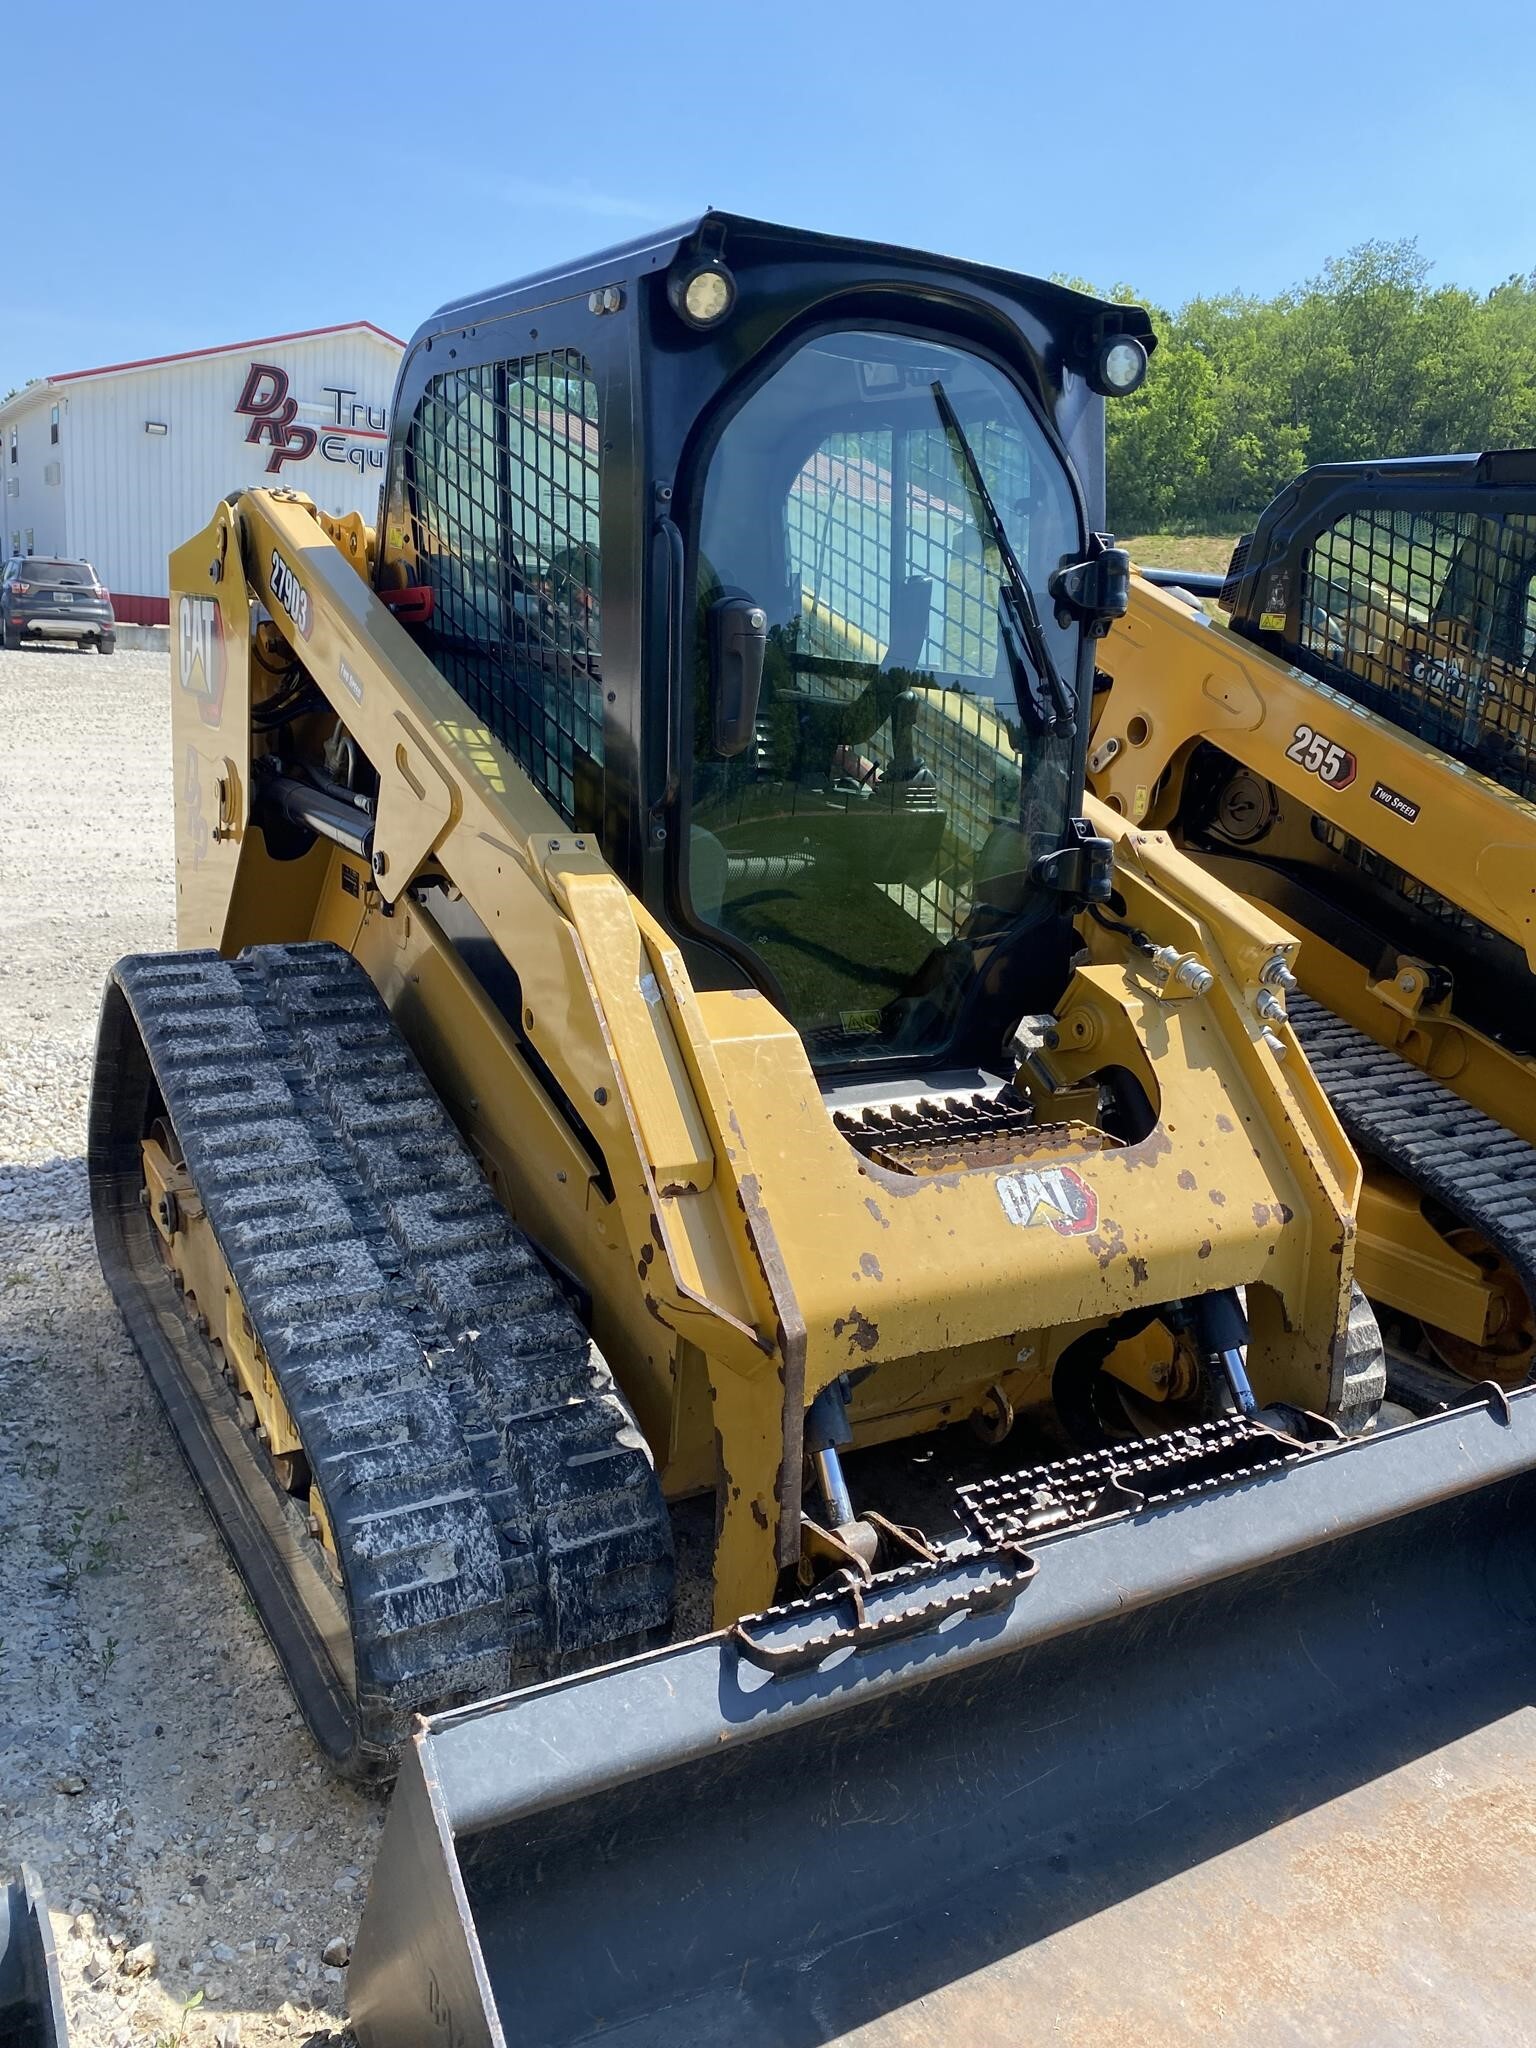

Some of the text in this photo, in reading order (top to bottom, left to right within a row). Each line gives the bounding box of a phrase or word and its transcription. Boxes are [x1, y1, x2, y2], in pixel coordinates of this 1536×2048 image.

[270, 550, 309, 634] 279D3
[178, 596, 216, 696] CAT
[1286, 725, 1347, 782] 255
[996, 1169, 1080, 1227] CAT
